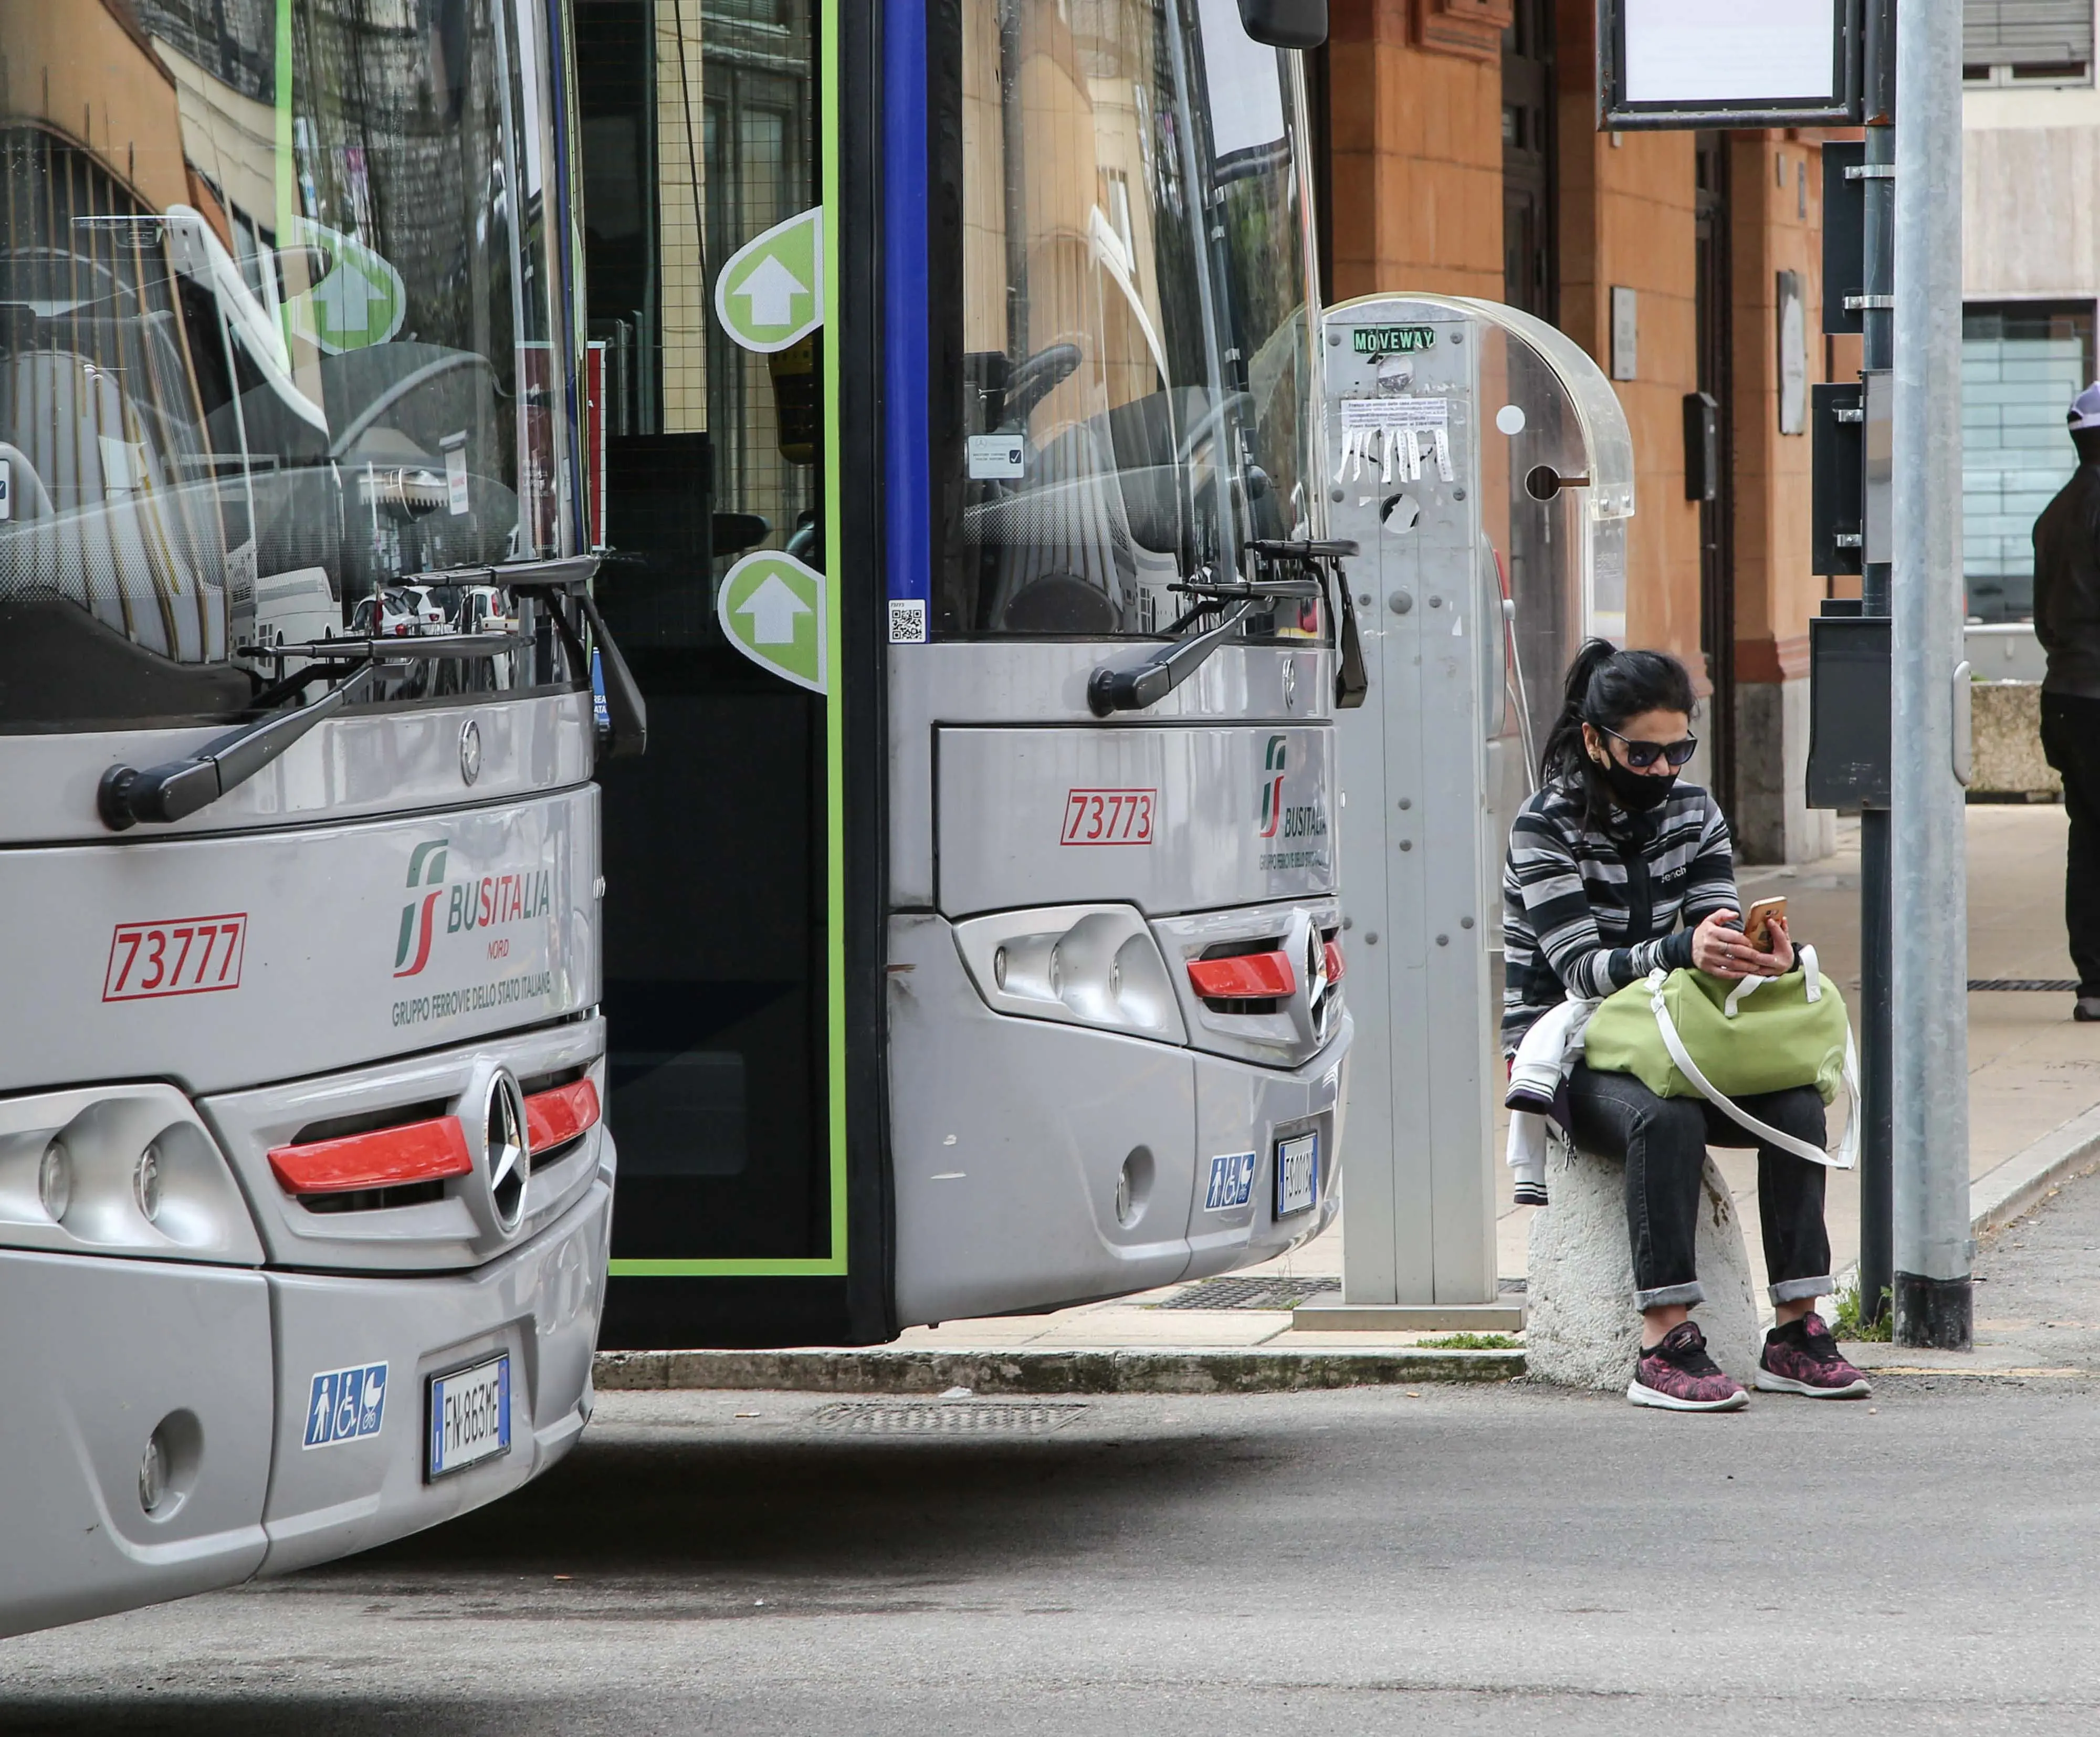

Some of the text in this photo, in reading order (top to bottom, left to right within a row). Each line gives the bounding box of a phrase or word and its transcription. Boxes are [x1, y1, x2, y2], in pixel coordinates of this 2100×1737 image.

[1355, 331, 1433, 351] MOVEWAY
[1068, 796, 1151, 839] 73773
[447, 870, 549, 934] BUSITALIA
[114, 923, 239, 992] 73777
[487, 939, 509, 960] NORD
[392, 971, 550, 1027] GRUPPO FERROVIE DELLO STATO ITALIANE
